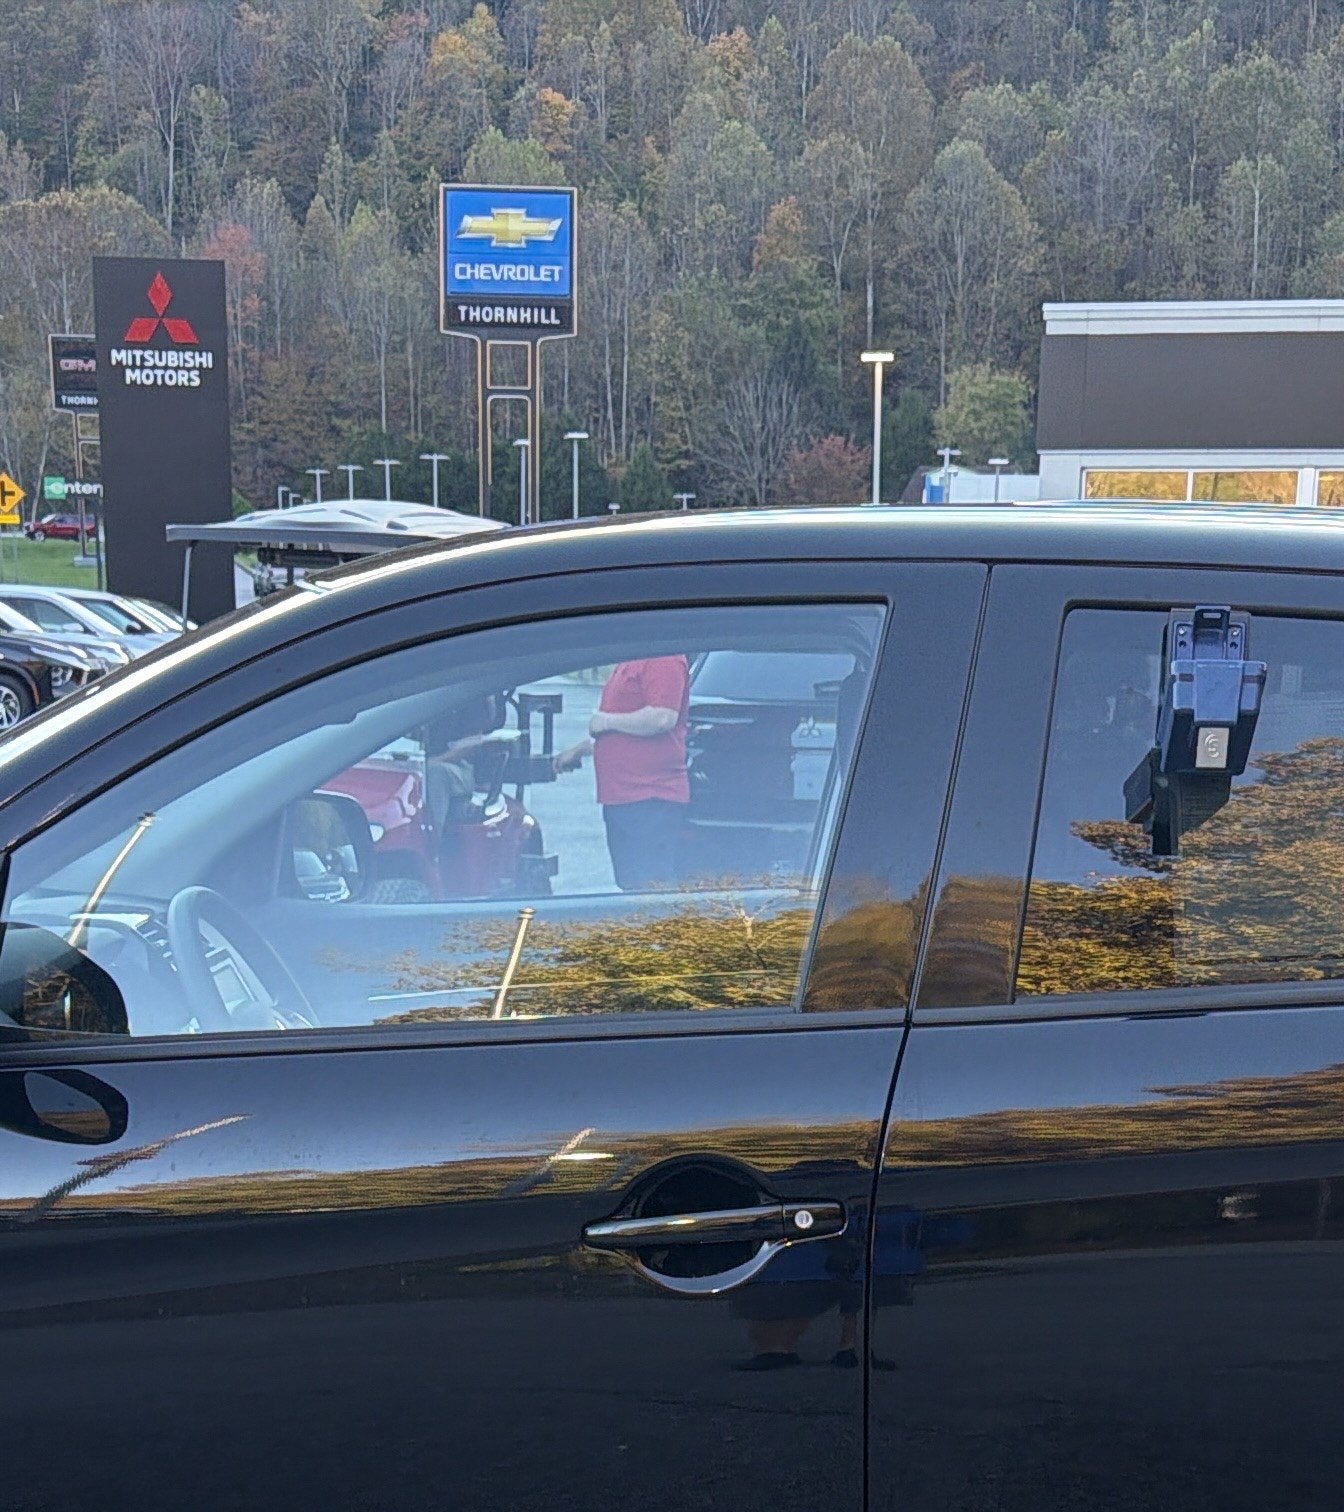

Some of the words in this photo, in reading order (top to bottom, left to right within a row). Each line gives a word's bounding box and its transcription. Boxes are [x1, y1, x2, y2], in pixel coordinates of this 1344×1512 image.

[454, 263, 563, 282] CHEVROLET
[458, 305, 561, 325] THORNHILL
[59, 358, 96, 372] GM
[110, 348, 213, 369] MITSUBISHI
[125, 368, 201, 387] MOTORS
